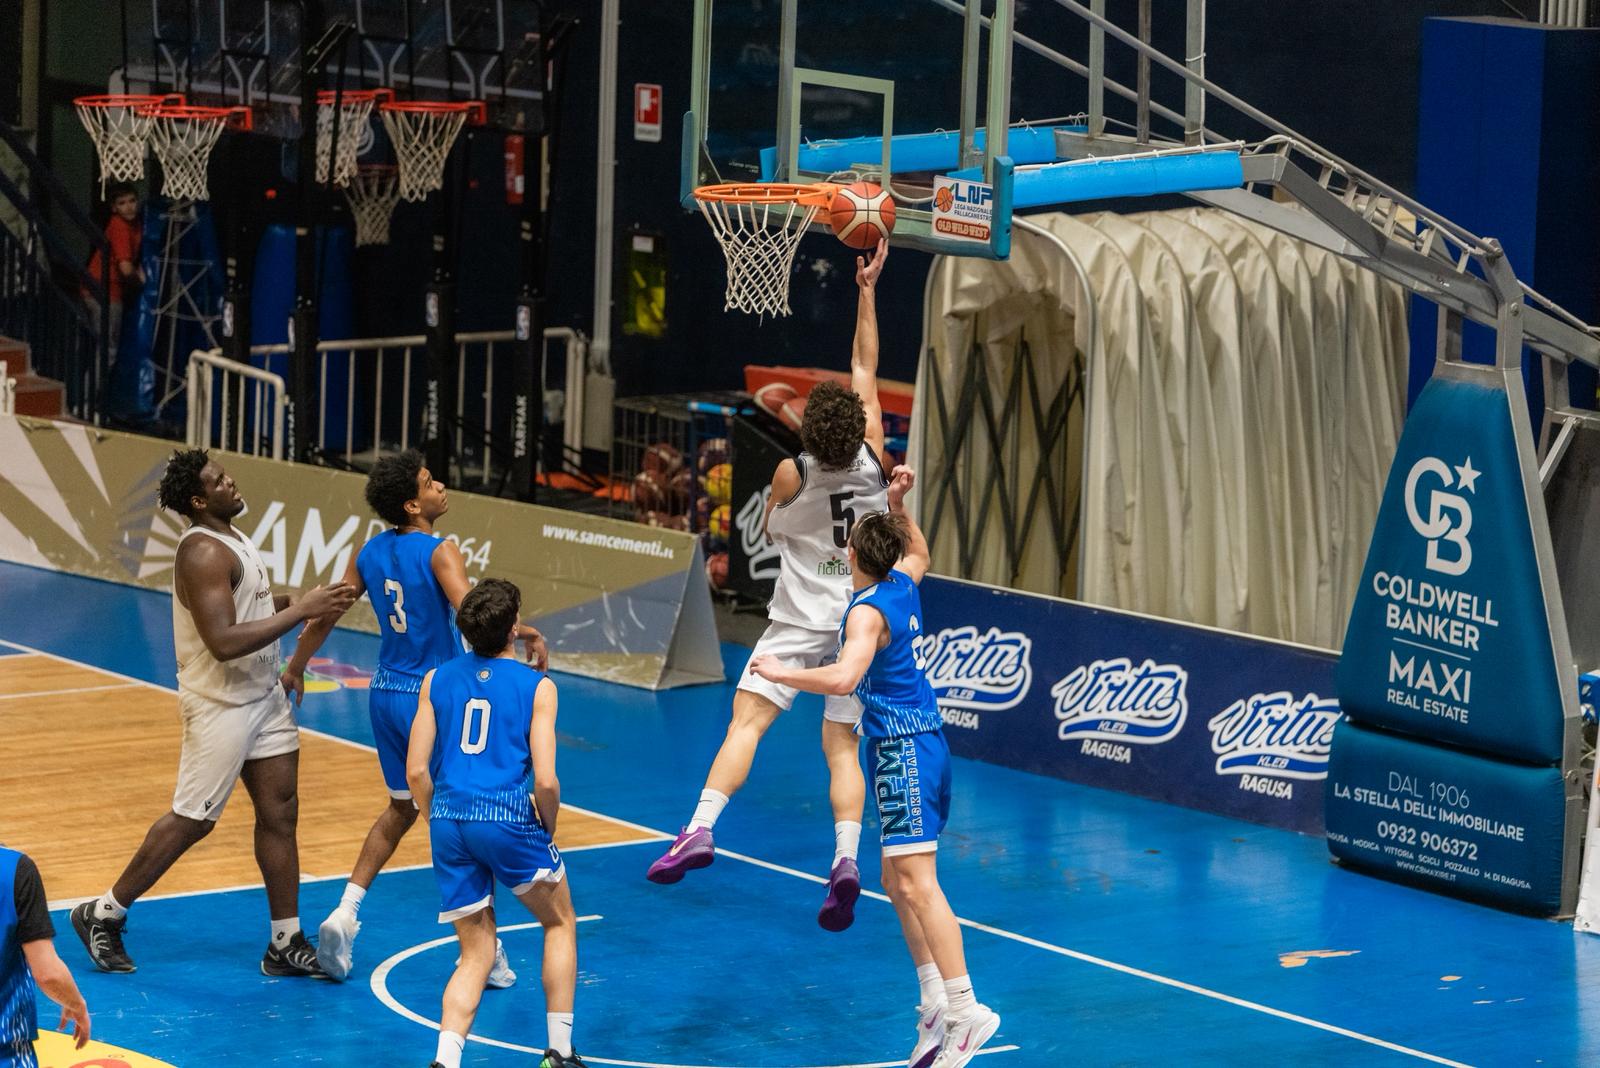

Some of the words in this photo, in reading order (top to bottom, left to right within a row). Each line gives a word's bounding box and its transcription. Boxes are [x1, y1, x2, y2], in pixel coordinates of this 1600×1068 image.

[955, 183, 993, 205] LNP
[937, 220, 951, 232] OLD
[952, 223, 968, 235] WILD
[969, 226, 989, 239] WEST
[427, 380, 438, 440] TARMAK
[515, 395, 527, 457] TARMAK
[237, 499, 361, 588] AM
[543, 524, 674, 559] www.samcementi.it
[829, 491, 856, 549] 5
[384, 578, 408, 633] 3
[1373, 571, 1499, 627] COLDWELL
[1386, 602, 1480, 651] BANKER
[946, 688, 976, 700] KLEB
[1051, 658, 1188, 720] Virtus
[1389, 649, 1471, 704] MAXI
[460, 698, 492, 755] 0
[938, 706, 979, 730] AGUSA
[1097, 720, 1128, 734] KLEB
[1387, 688, 1420, 710] REAL
[1423, 698, 1469, 724] ESTATE
[1080, 739, 1132, 763] RAGUSA
[1256, 755, 1290, 769] KLEB
[904, 738, 924, 837] BASKETBALL
[1239, 774, 1293, 800] RAGUSA
[1388, 771, 1424, 798] DAL
[1429, 781, 1470, 809] 1906
[1334, 782, 1351, 800] LA
[1354, 787, 1401, 812] STELLA
[1404, 799, 1437, 820] DELL'
[1439, 807, 1525, 842] IMMOBILIARE
[1353, 838, 1380, 851] MODICA
[1383, 845, 1414, 860] VITTORIA
[1418, 854, 1440, 867] SCICLI
[1444, 860, 1480, 877] POZZALLO
[1492, 872, 1501, 882] DI
[1501, 875, 1531, 890] RAGUSA
[1377, 820, 1417, 846] 0932
[1421, 831, 1478, 861] 906372
